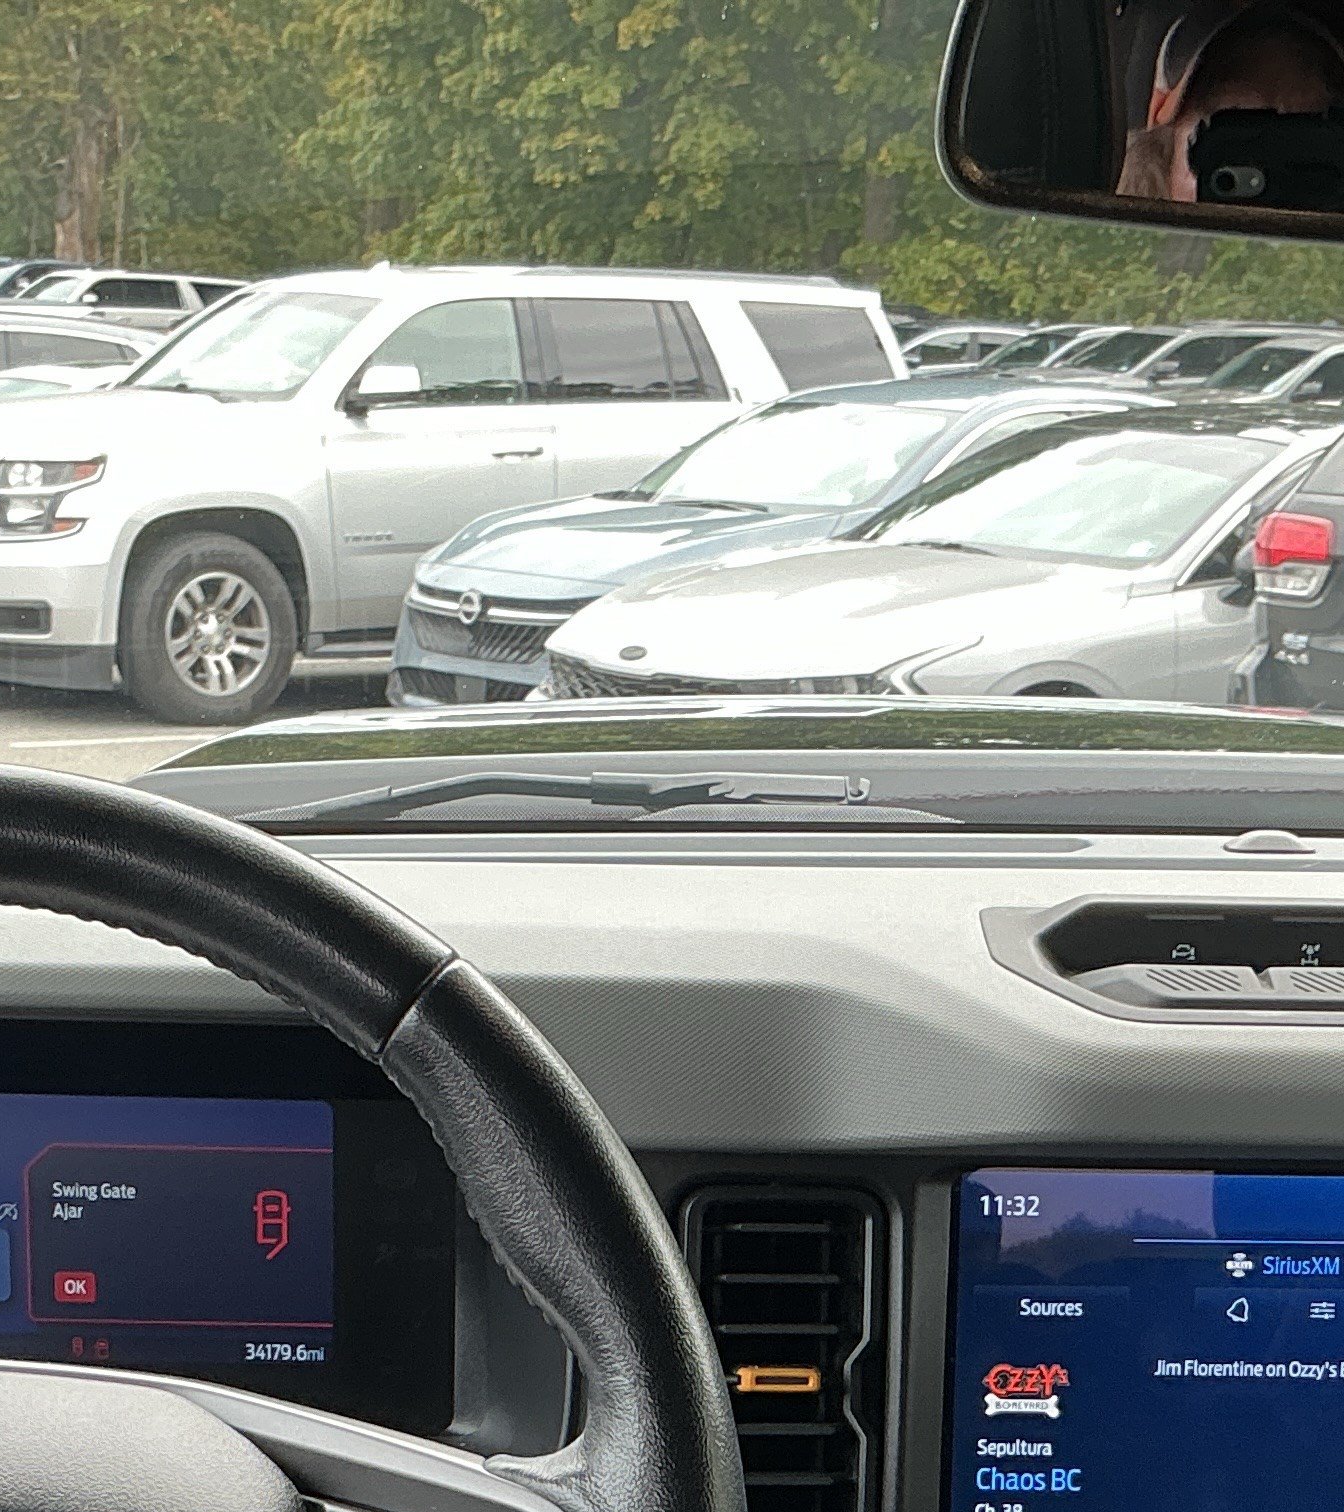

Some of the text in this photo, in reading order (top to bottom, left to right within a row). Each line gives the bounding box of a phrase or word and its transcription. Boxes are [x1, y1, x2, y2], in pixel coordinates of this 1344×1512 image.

[52, 1181, 136, 1201] Swing Gate
[52, 1202, 83, 1221] Ajar
[979, 1194, 1040, 1217] 11:32
[1262, 1255, 1340, 1275] SiriusXM
[64, 1279, 87, 1295] OK
[1019, 1298, 1084, 1317] Sources
[1154, 1359, 1181, 1377] Jim
[1184, 1359, 1263, 1377] Florentine
[1265, 1363, 1286, 1377] on
[1289, 1361, 1337, 1381] Ozzy's
[976, 1438, 1053, 1458] Sepultura
[976, 1466, 1082, 1492] Chaos BC
